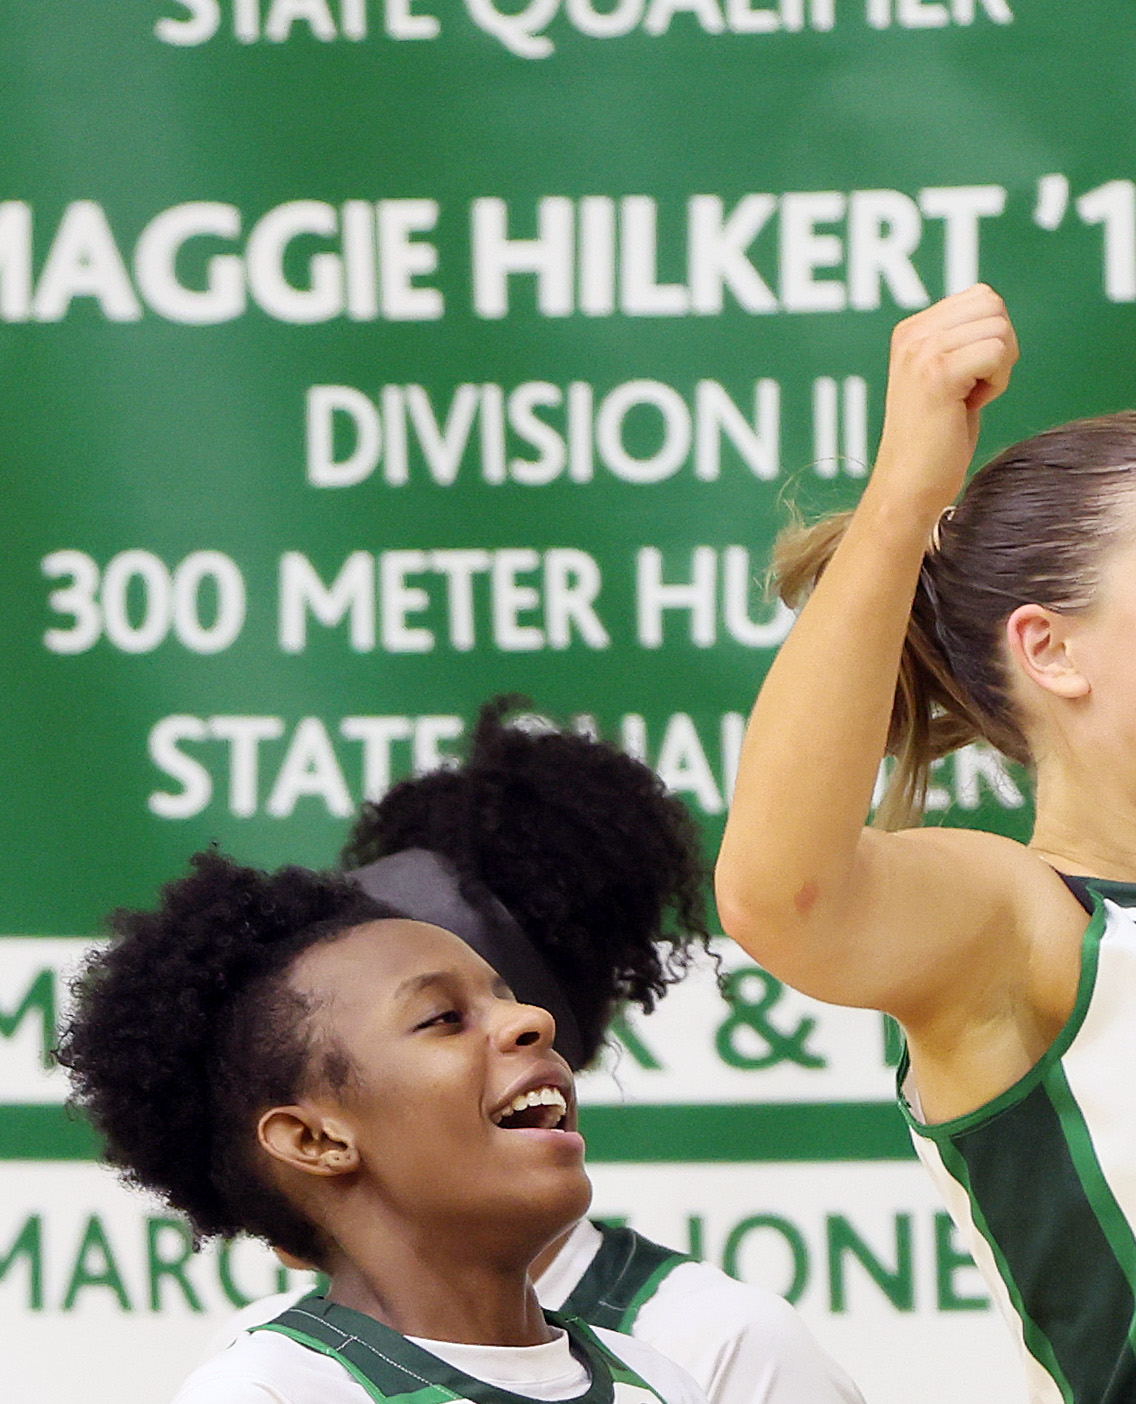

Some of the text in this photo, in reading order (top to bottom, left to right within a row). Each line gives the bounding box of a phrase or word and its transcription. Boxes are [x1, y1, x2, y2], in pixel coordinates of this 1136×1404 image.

[472, 184, 1006, 320] HILKERT
[306, 378, 781, 488] DIVISION
[43, 549, 247, 655] 300
[278, 547, 610, 653] METER
